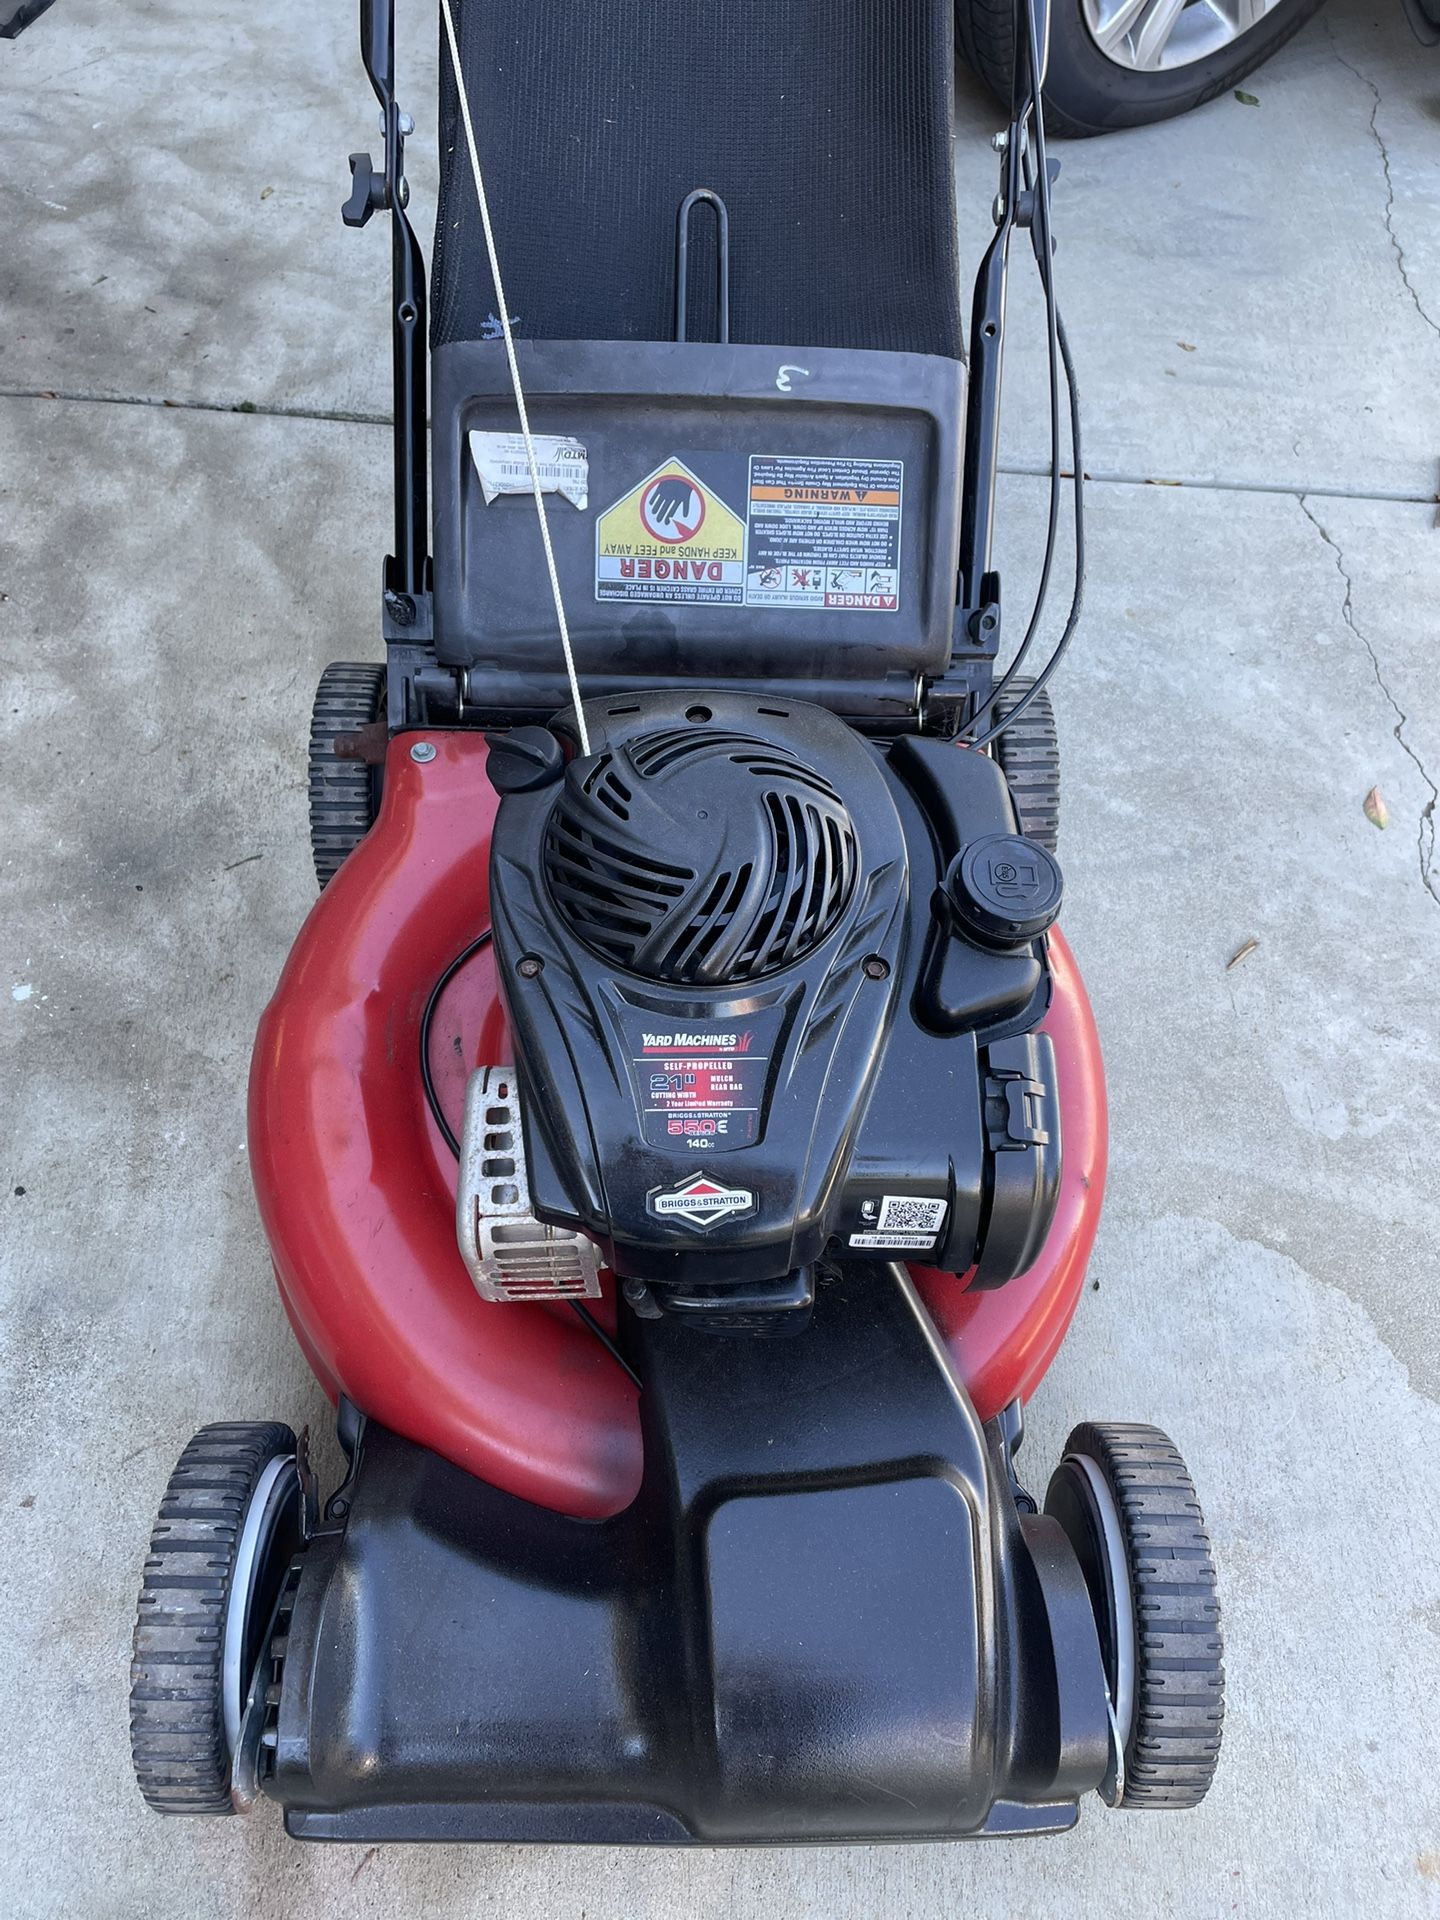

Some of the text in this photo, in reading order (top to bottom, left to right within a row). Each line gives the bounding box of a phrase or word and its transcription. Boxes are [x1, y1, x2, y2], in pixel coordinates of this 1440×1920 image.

[565, 451, 587, 460] MTD
[783, 488, 850, 500] WARNING
[603, 543, 736, 559] KEEP HANDS and FEET AWAY
[620, 558, 722, 581] DANGER
[629, 590, 664, 598] UNDAMAGED
[720, 593, 732, 601] NOT
[828, 593, 880, 606] DANGER
[641, 1033, 736, 1046] YARD MACHINES
[663, 1061, 733, 1070] SELF-PROPELLED
[649, 1073, 696, 1091] 21"
[660, 1195, 746, 1208] BRIGGS&STRATTON
